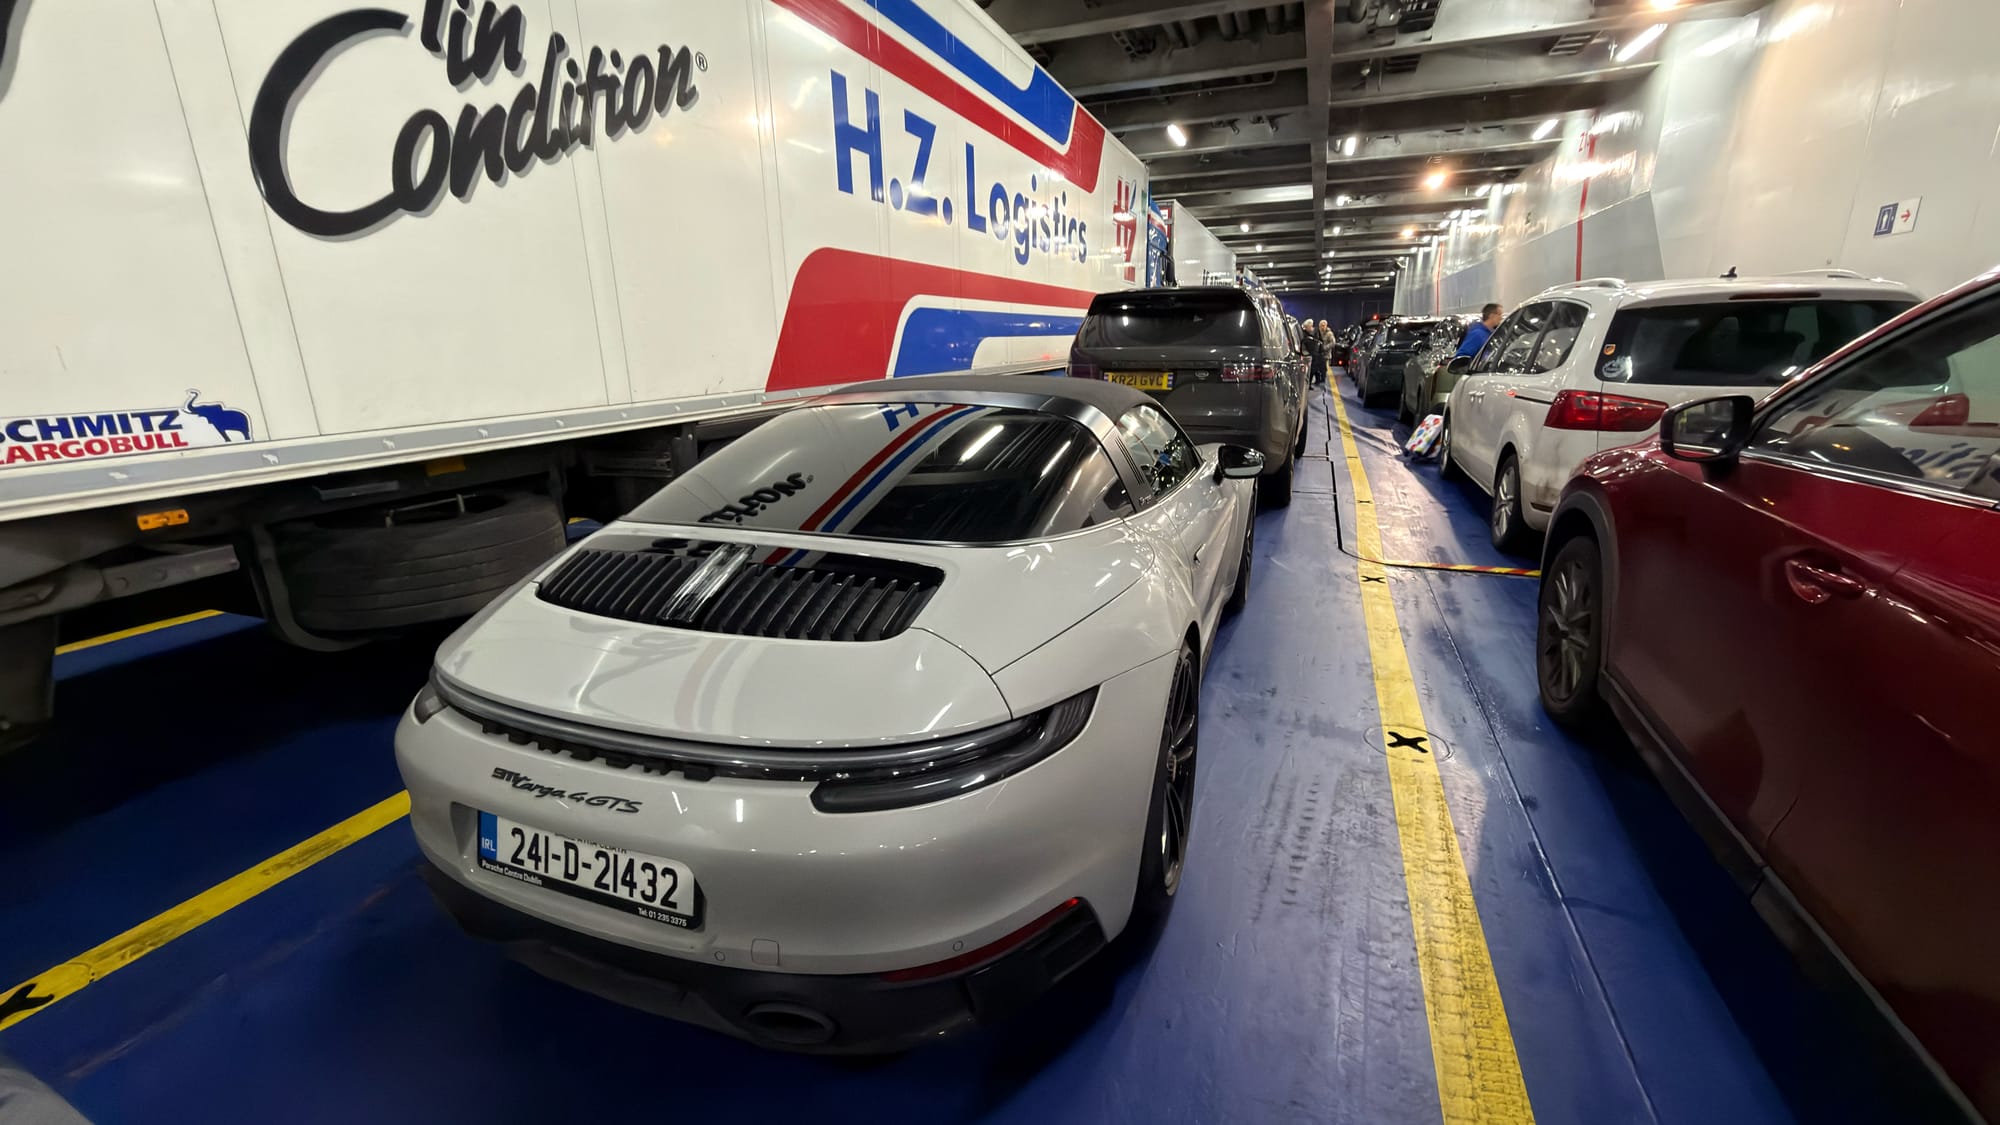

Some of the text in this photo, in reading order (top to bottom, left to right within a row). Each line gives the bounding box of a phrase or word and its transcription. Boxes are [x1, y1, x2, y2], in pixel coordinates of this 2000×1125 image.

[831, 69, 1088, 266] H.Z. Logistics
[1111, 374, 1164, 387] KR21 GVC
[0, 410, 183, 443] CHMITZ
[0, 431, 189, 466] ARGOBULL
[568, 792, 589, 803] 4
[585, 795, 643, 814] GTS
[481, 836, 497, 853] IRL
[510, 827, 678, 910] 241-D-21432
